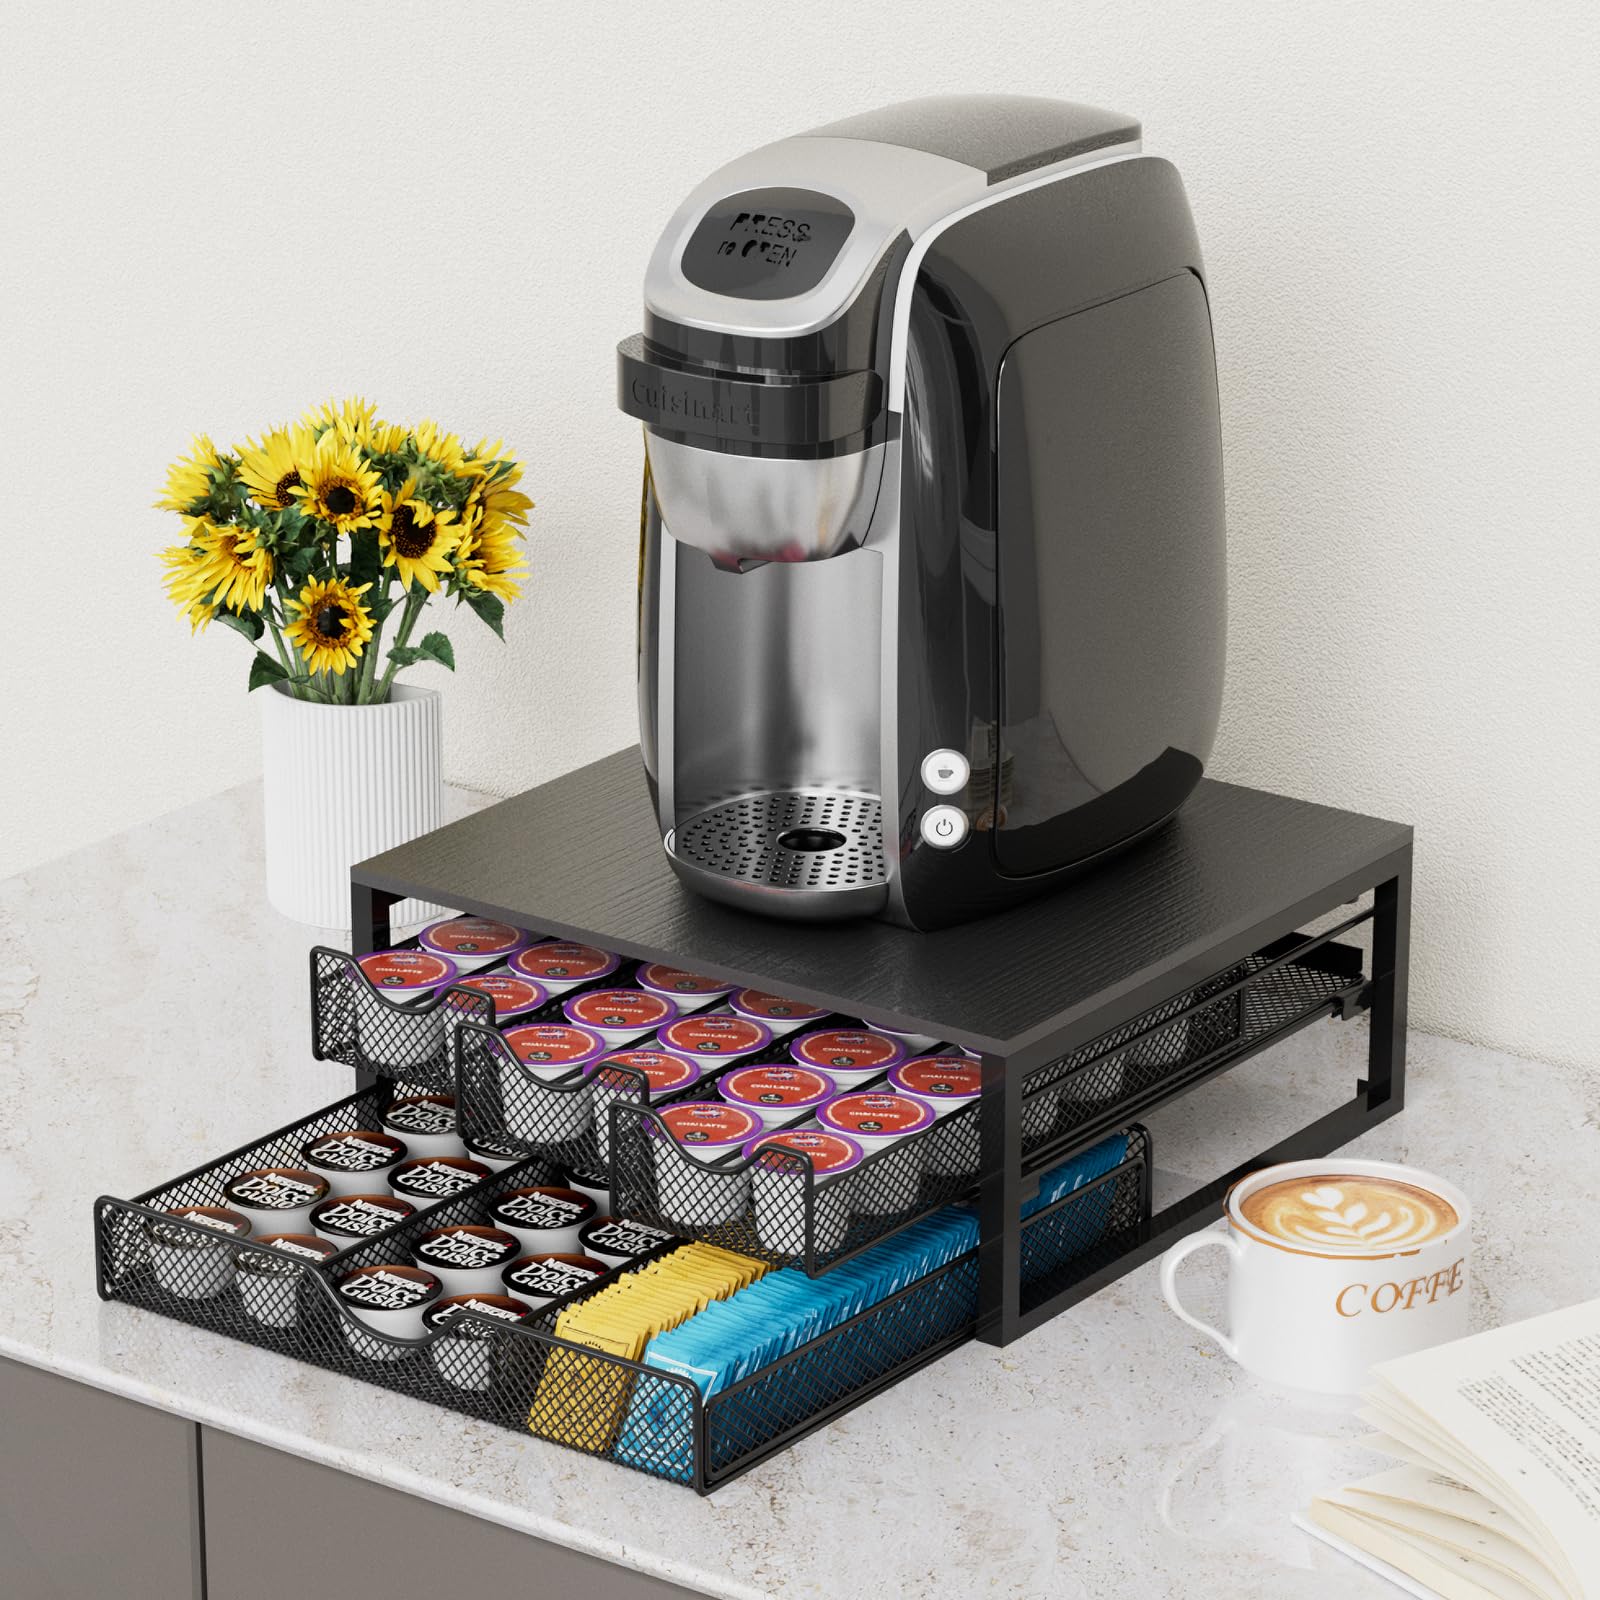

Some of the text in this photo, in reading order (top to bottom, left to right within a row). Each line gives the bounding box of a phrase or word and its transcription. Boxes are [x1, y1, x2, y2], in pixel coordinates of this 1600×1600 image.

[310, 1148, 373, 1170] Gusto
[320, 1139, 387, 1166] Dolce
[232, 1185, 295, 1208] Gusto
[242, 1176, 310, 1203] Dolce
[497, 1204, 562, 1228] Gusto
[507, 1195, 576, 1222] Dolce
[419, 1243, 486, 1268] Gusto
[430, 1234, 500, 1262] Dolce
[340, 1284, 407, 1308] Gusto
[351, 1274, 421, 1302] Dolce
